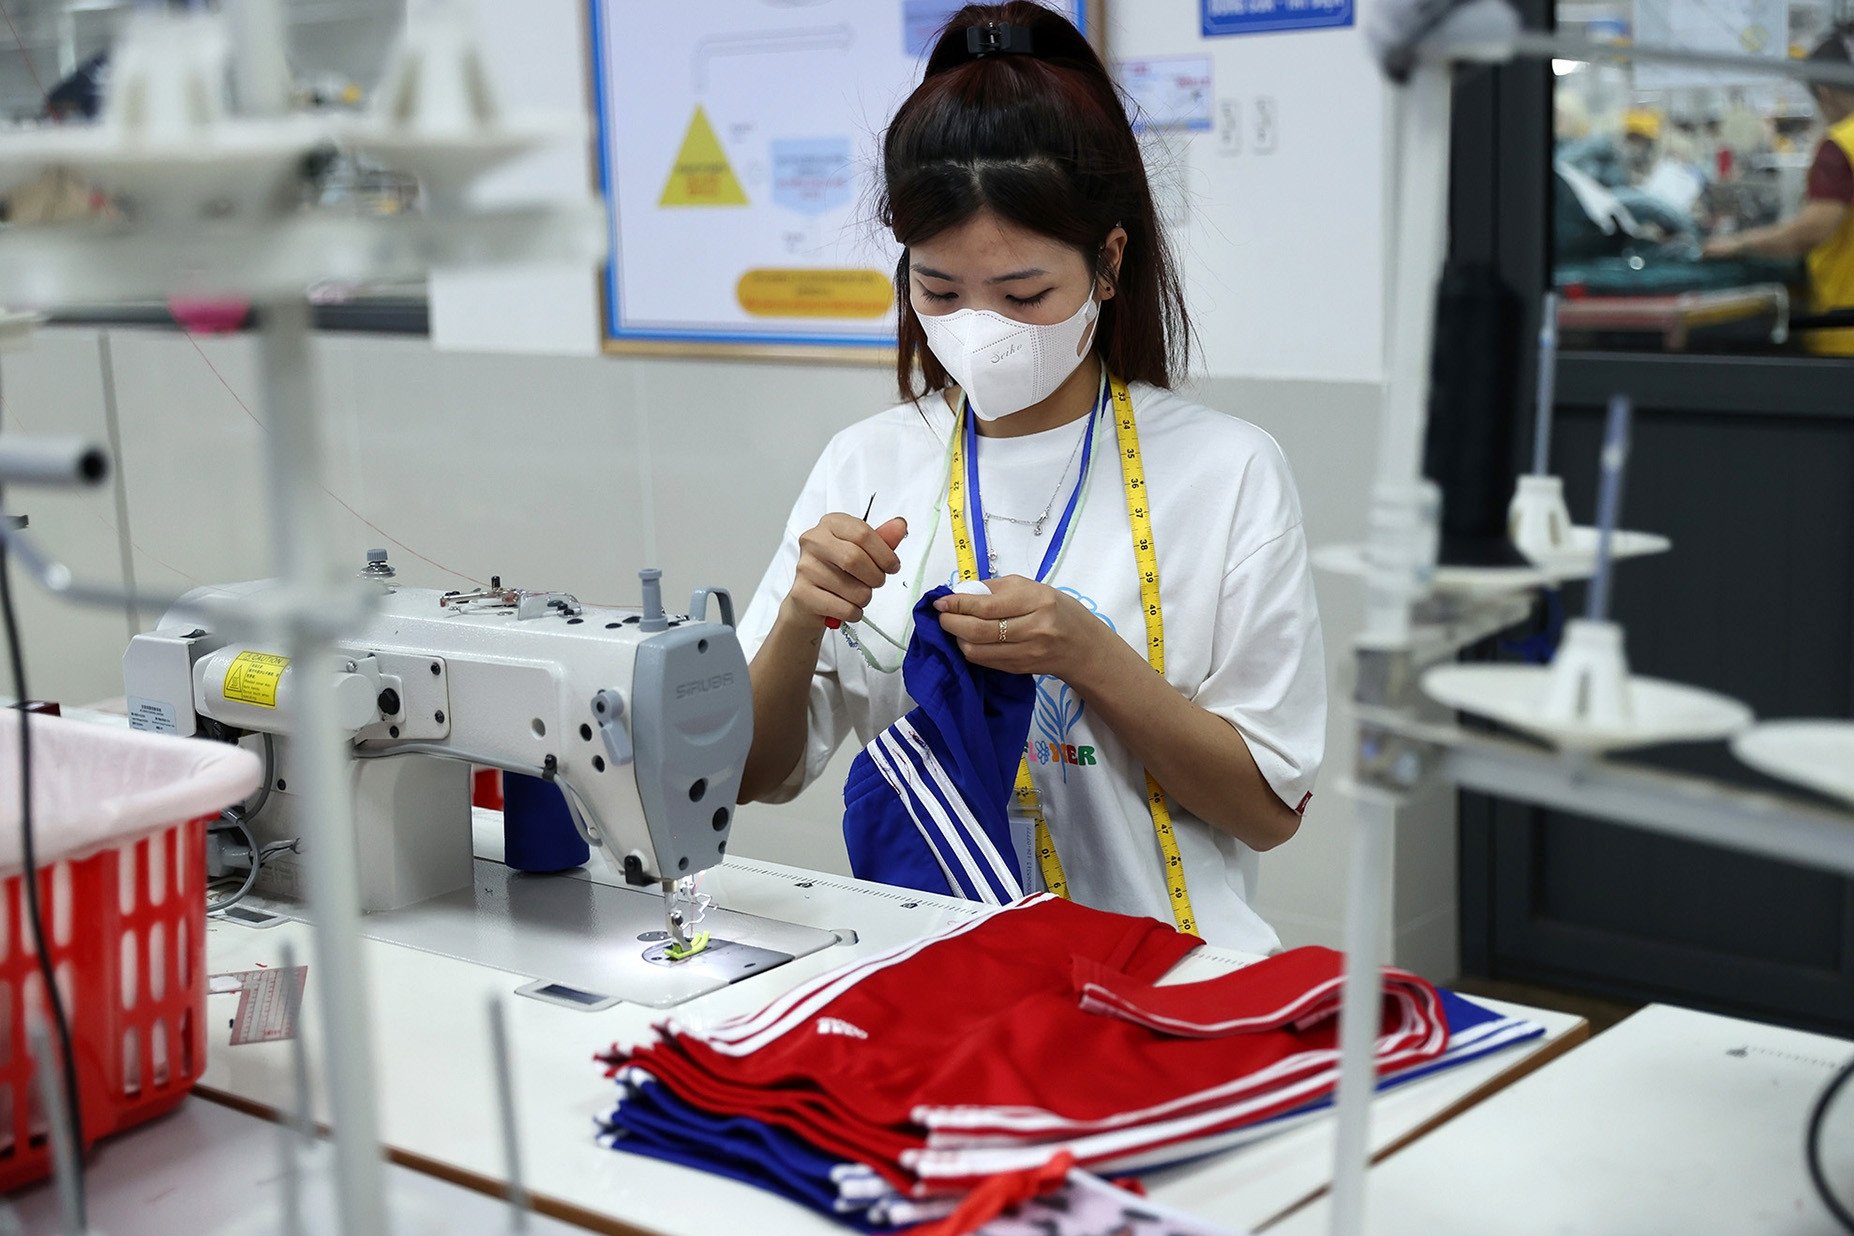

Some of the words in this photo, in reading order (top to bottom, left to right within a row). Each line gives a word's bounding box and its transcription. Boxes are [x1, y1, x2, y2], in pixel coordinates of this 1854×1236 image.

[1117, 391, 1127, 402] 33
[1122, 419, 1131, 430] 34
[1126, 448, 1136, 459] 35
[1130, 478, 1140, 489] 36
[1134, 507, 1144, 519] 37
[958, 538, 967, 550] 20
[1139, 538, 1149, 551] 38
[963, 569, 971, 580] 19
[1145, 571, 1154, 583] 39
[1149, 604, 1157, 616] 40
[1152, 636, 1160, 648] 41
[251, 654, 282, 665] CAUTION
[1153, 792, 1161, 804] 46
[1161, 823, 1169, 835] 47
[1041, 848, 1051, 860] 10
[1170, 855, 1178, 867] 48
[1174, 887, 1183, 899] 49
[1182, 918, 1191, 930] 50
